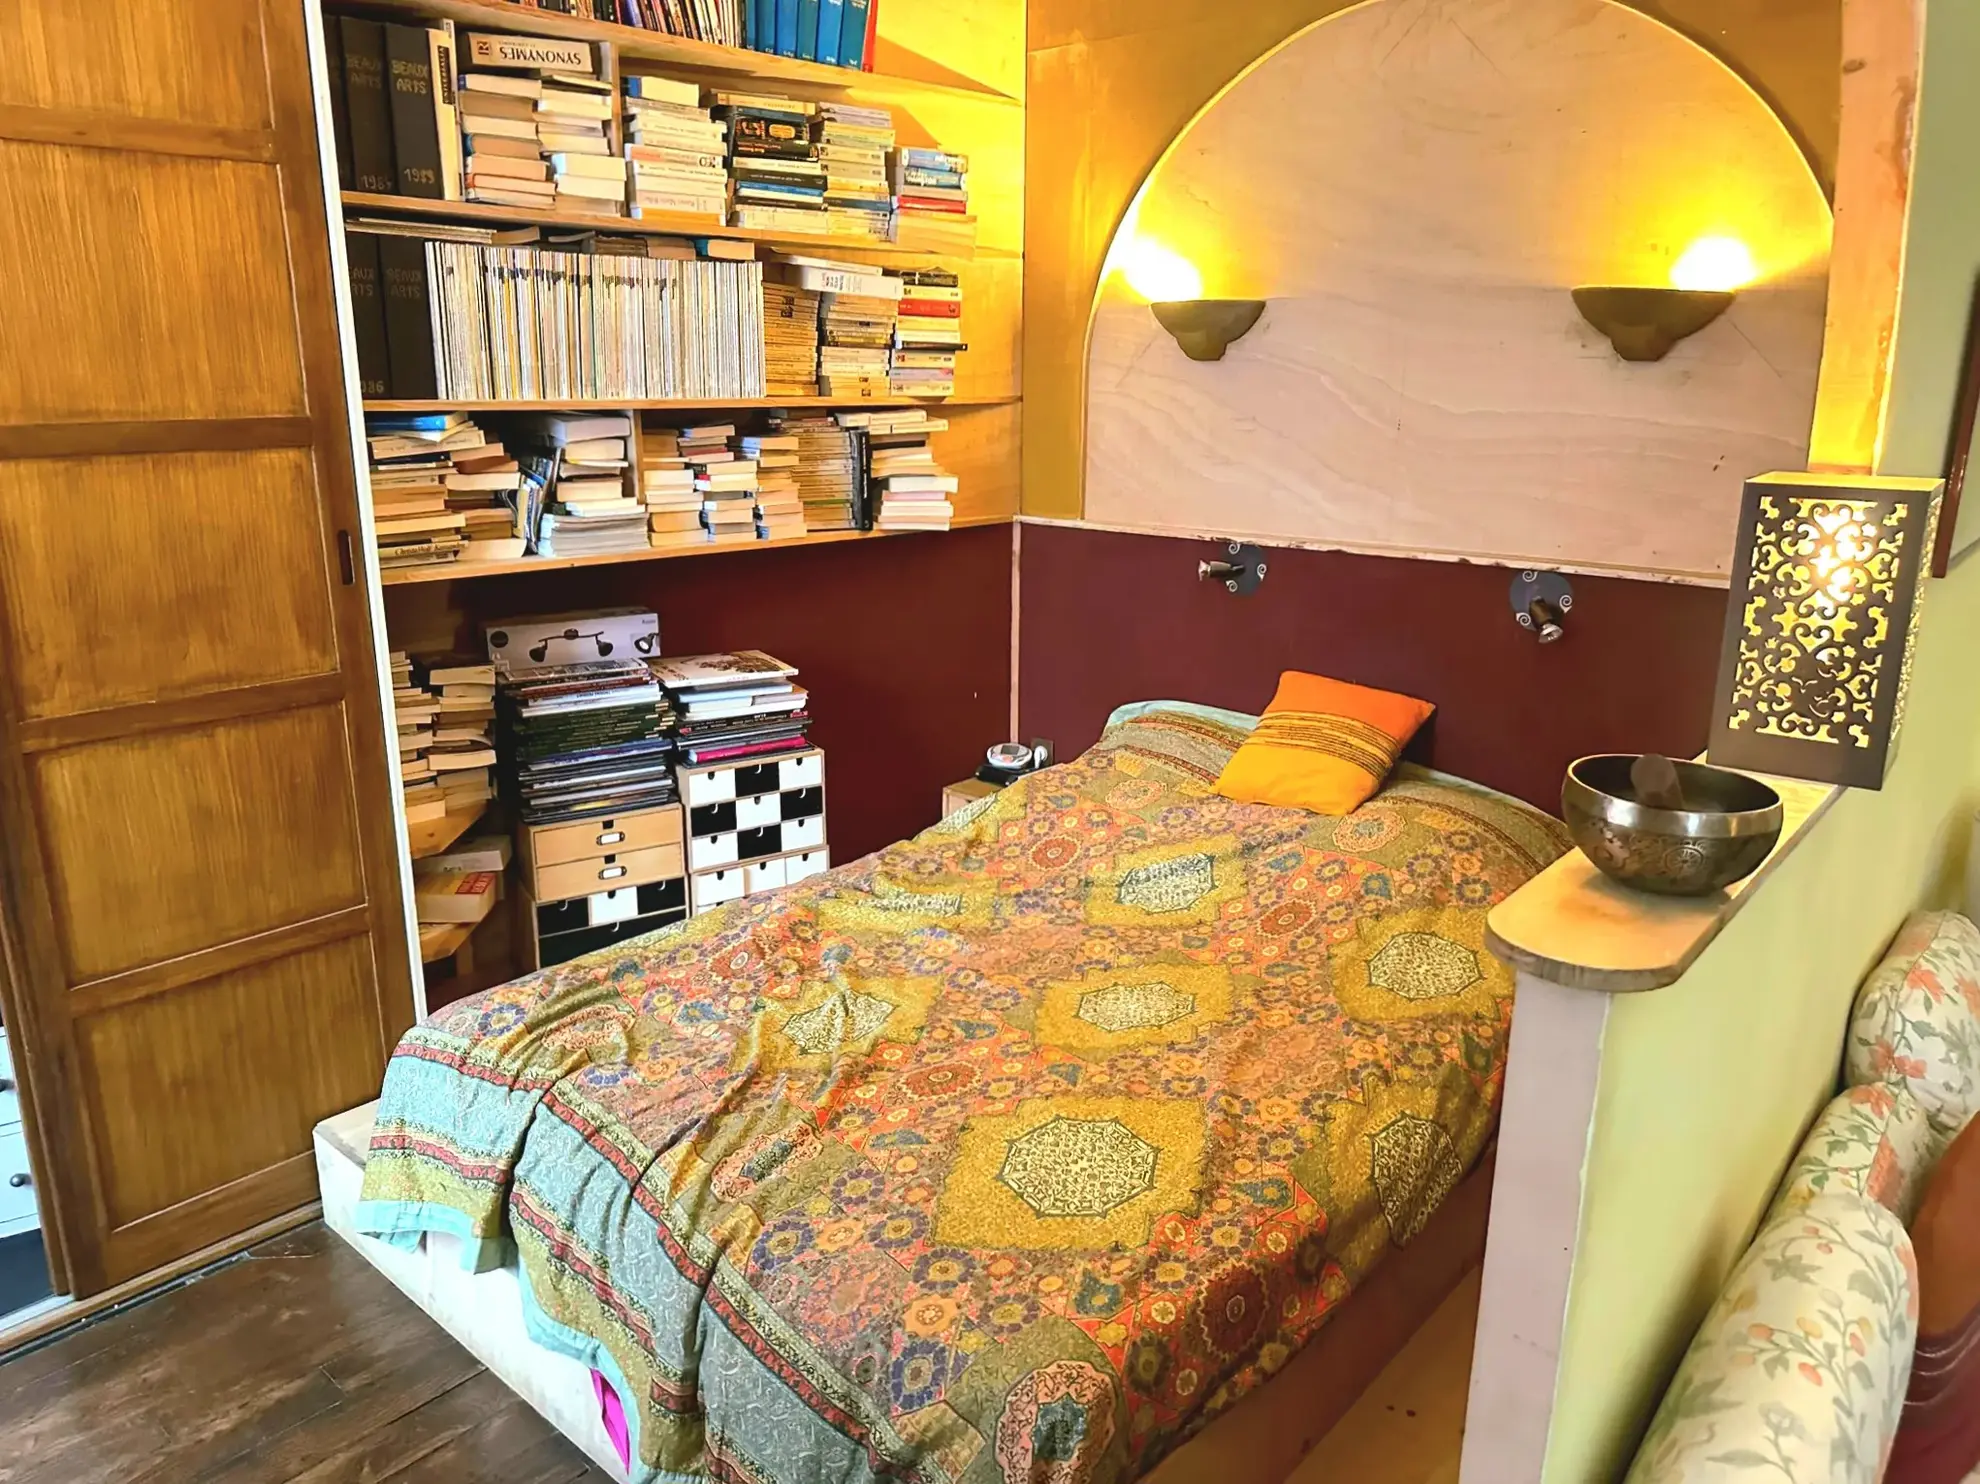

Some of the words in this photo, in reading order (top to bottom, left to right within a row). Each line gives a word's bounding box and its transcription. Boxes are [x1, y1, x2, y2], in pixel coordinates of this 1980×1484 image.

[499, 46, 582, 65] SYNONYMES
[390, 59, 428, 78] BEAUX
[396, 78, 427, 94] ARTS
[349, 266, 374, 281] EAUX
[386, 268, 422, 283] BEAUX
[351, 283, 374, 297] RTS
[390, 284, 421, 299] ARTS
